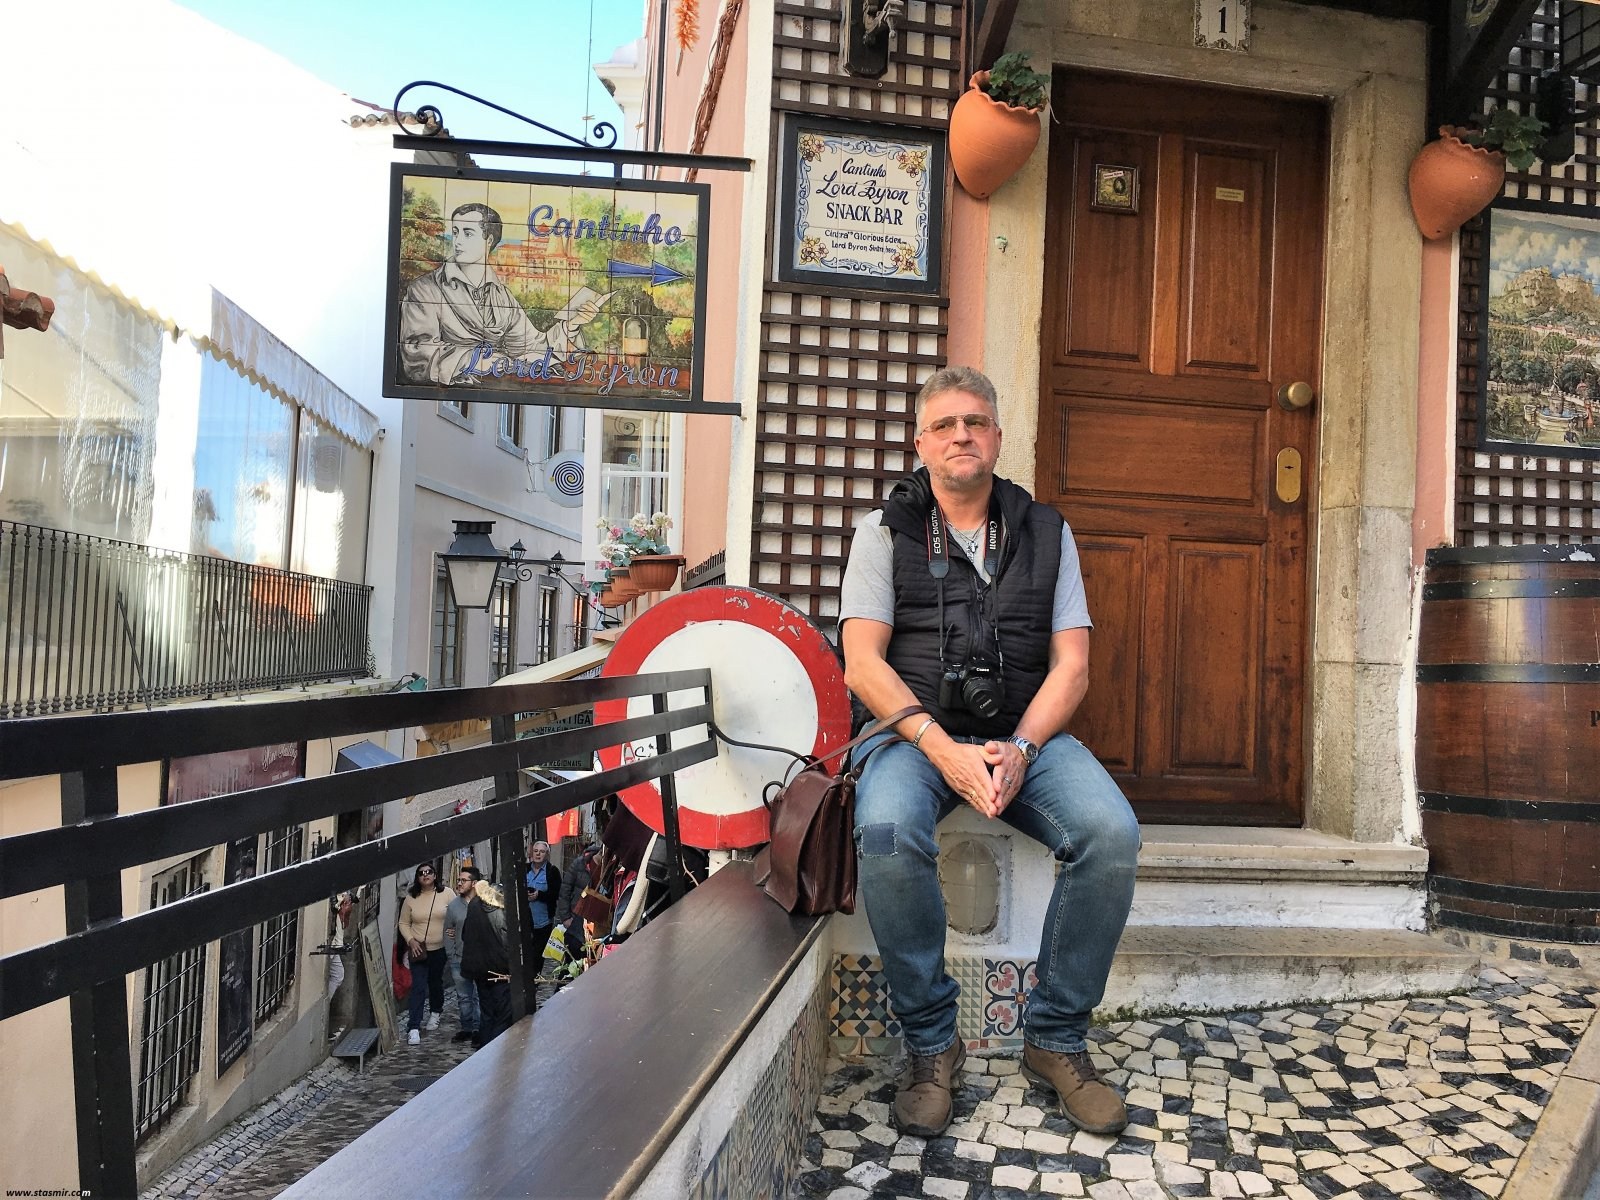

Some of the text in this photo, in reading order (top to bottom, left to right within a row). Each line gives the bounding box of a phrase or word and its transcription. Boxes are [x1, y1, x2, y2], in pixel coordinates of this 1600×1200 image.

[1218, 6, 1228, 34] 1
[842, 158, 887, 179] Cantinho
[816, 170, 909, 205] Lord Byron
[527, 204, 686, 247] Cantinho
[826, 202, 903, 226] SNACK BAR
[832, 240, 846, 249] Lord
[848, 242, 868, 251] Byron
[463, 341, 679, 396] Lord Byron
[931, 506, 941, 554] EOS DIGITAL
[989, 520, 998, 550] Canon
[980, 699, 992, 709] Canon
